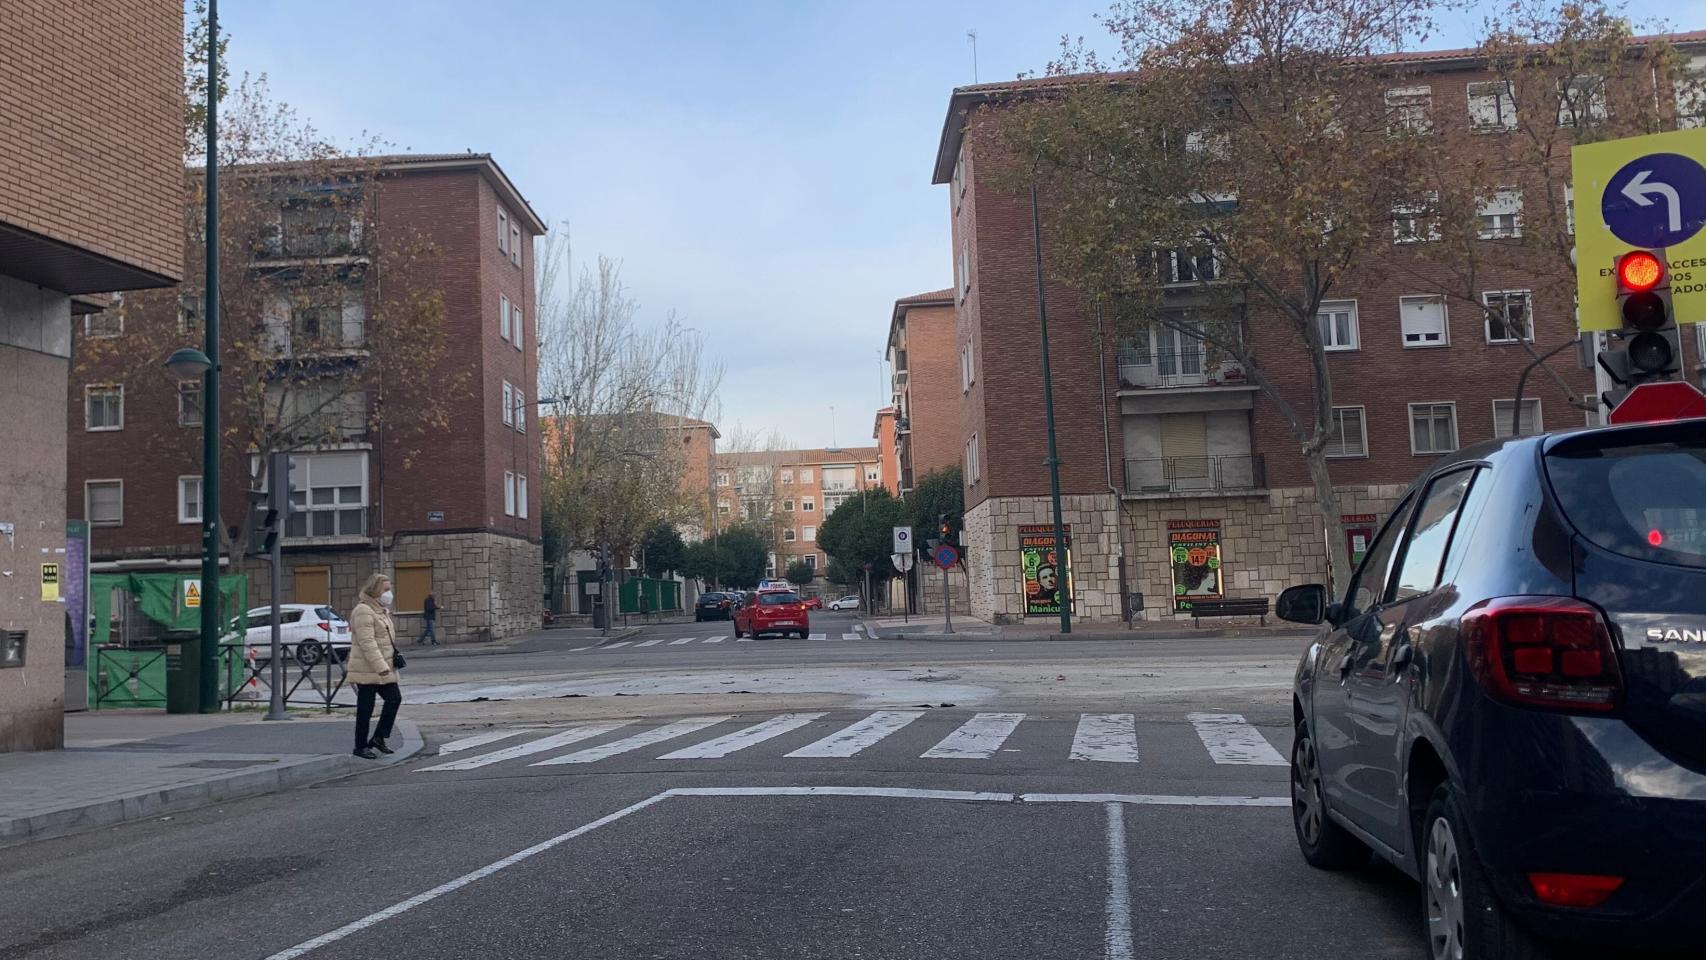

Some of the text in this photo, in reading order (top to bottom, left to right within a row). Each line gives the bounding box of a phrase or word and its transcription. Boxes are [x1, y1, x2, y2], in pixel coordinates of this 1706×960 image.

[1673, 283, 1706, 294] ADO
[1019, 525, 1070, 533] PELUQUES
[1172, 532, 1217, 541] DIAGONAL
[1023, 537, 1068, 545] DIAGONL
